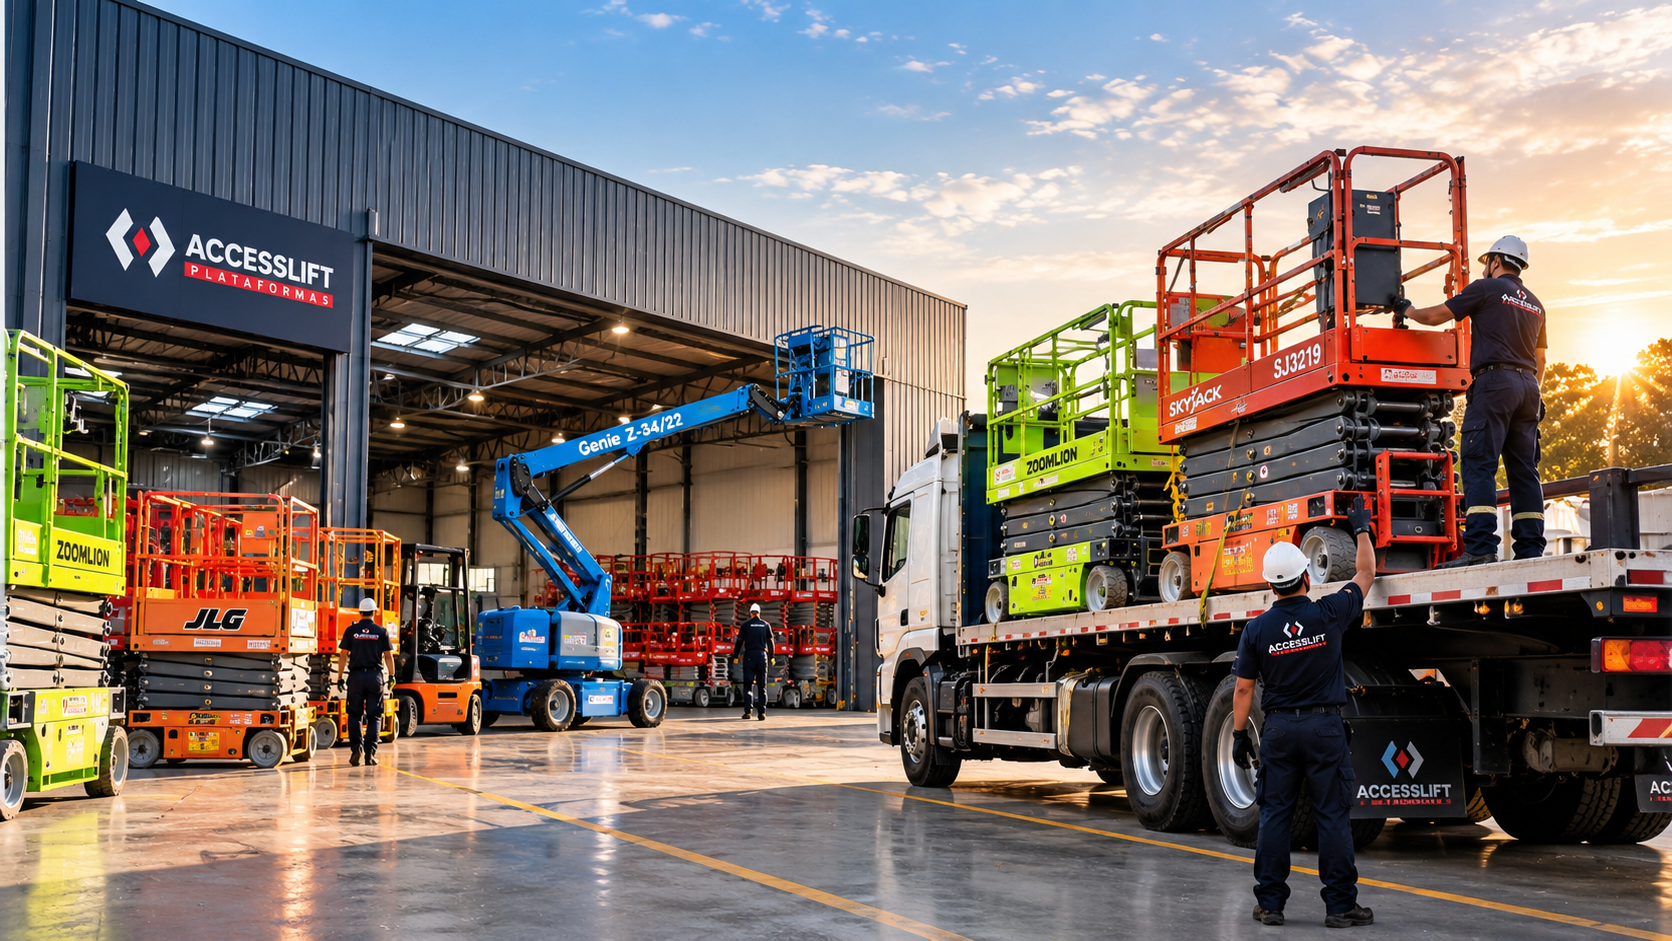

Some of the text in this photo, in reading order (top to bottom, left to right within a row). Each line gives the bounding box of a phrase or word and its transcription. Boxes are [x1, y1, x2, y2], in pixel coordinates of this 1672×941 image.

[185, 233, 334, 289] ACCESSLIFT
[190, 265, 329, 306] PLATAFORMAS
[1273, 343, 1321, 379] SJ3219
[1169, 384, 1222, 417] SKYJACK
[578, 412, 684, 456] Genie Z-34/22
[1026, 446, 1078, 475] ZOOMLION
[56, 539, 110, 568] ZOOMLION
[183, 608, 248, 630] JLG
[1268, 633, 1326, 654] ACCESSLIFT
[1356, 783, 1452, 799] ACCESSLIFT
[1649, 780, 1672, 794] AC
